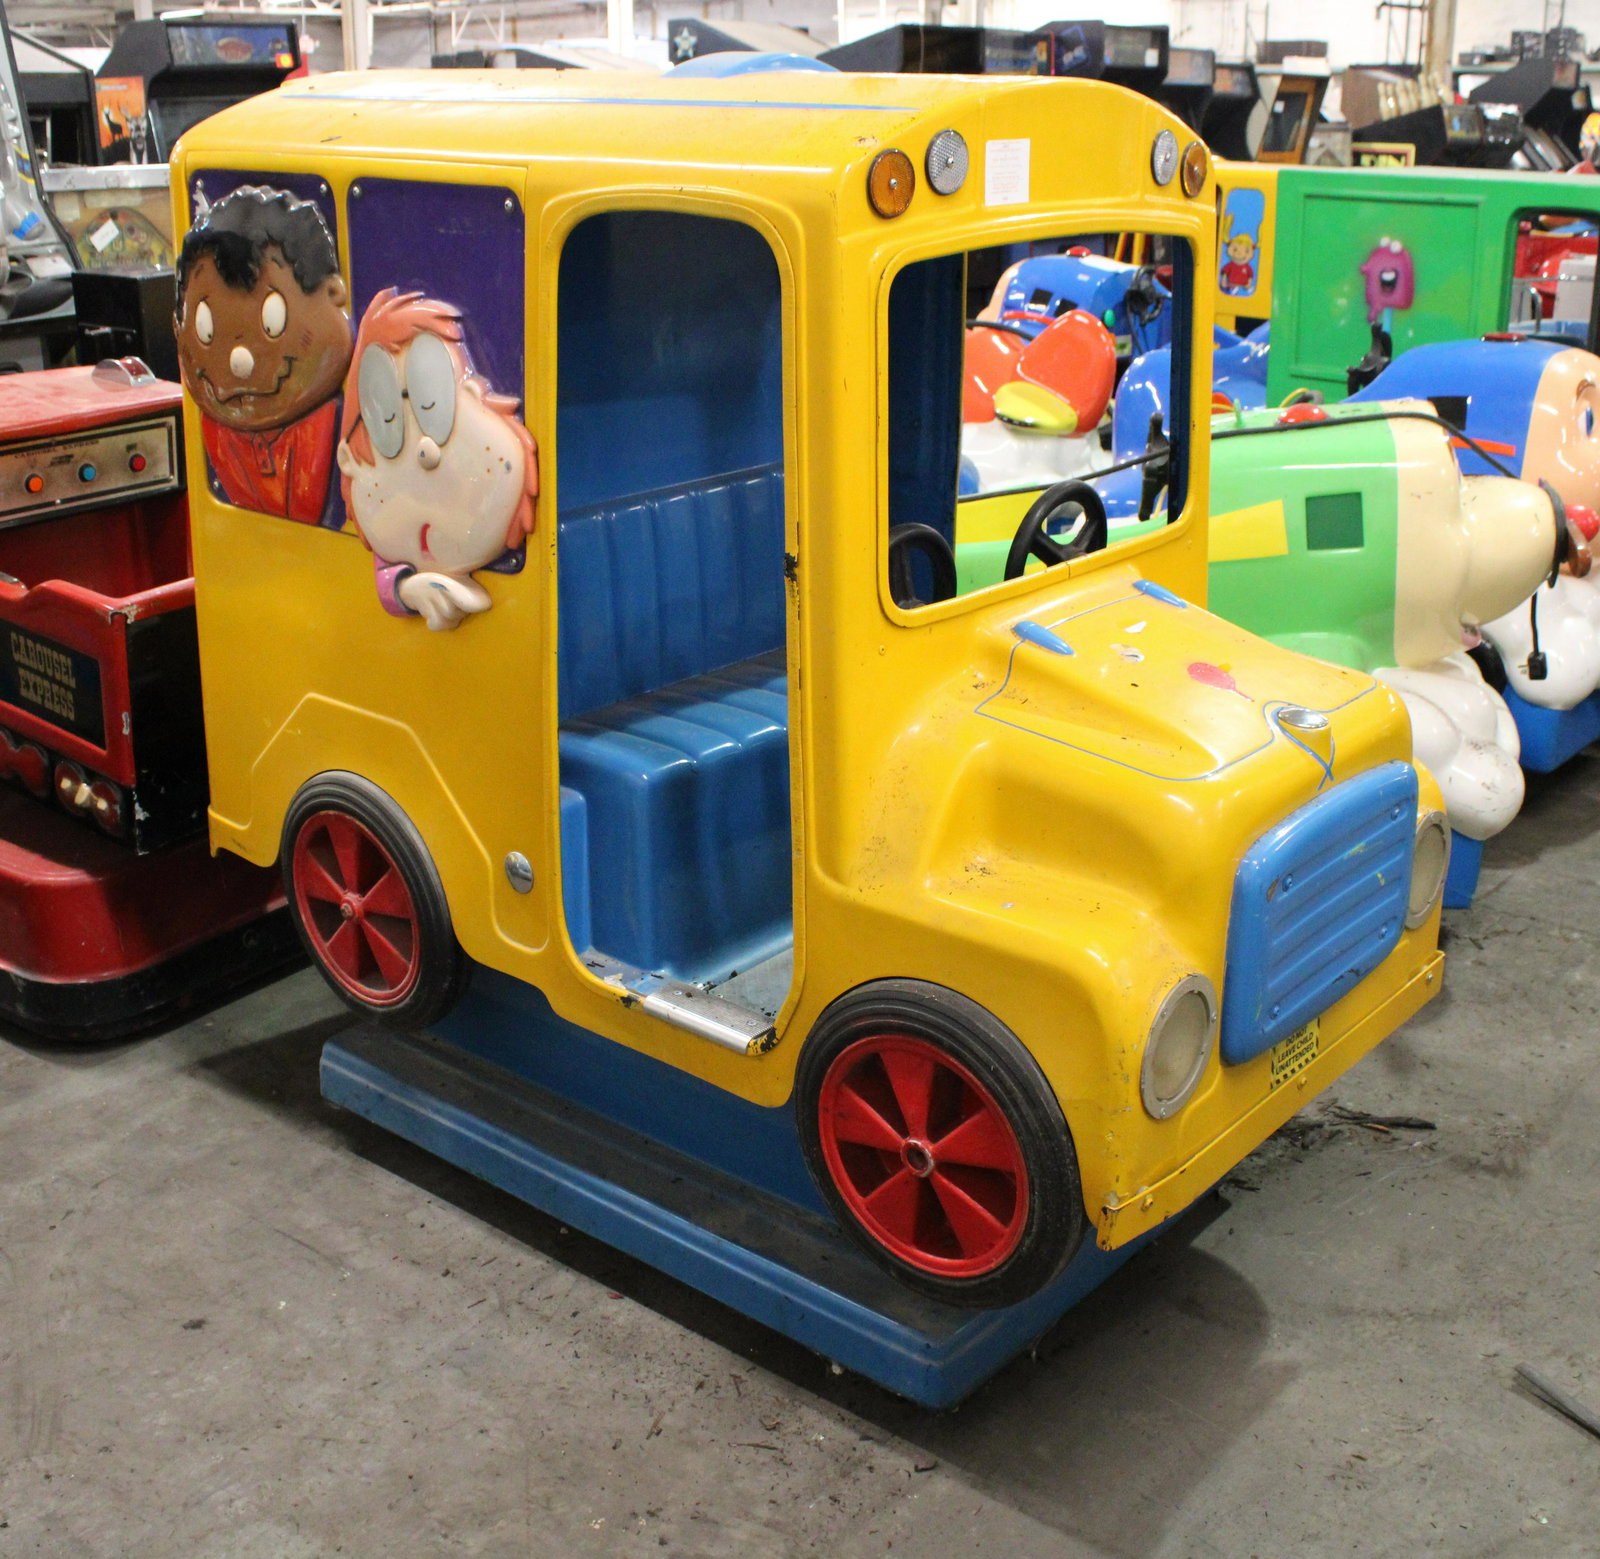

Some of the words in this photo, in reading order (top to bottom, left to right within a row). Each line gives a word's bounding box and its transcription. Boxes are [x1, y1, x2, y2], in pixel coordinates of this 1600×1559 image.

[10, 631, 76, 688] CAROUSEL
[18, 667, 75, 720] EXPRESS
[1276, 1042, 1314, 1074] UNATTENDED
[1278, 1046, 1296, 1063] LEAVE
[1297, 1032, 1314, 1050] CHILD
